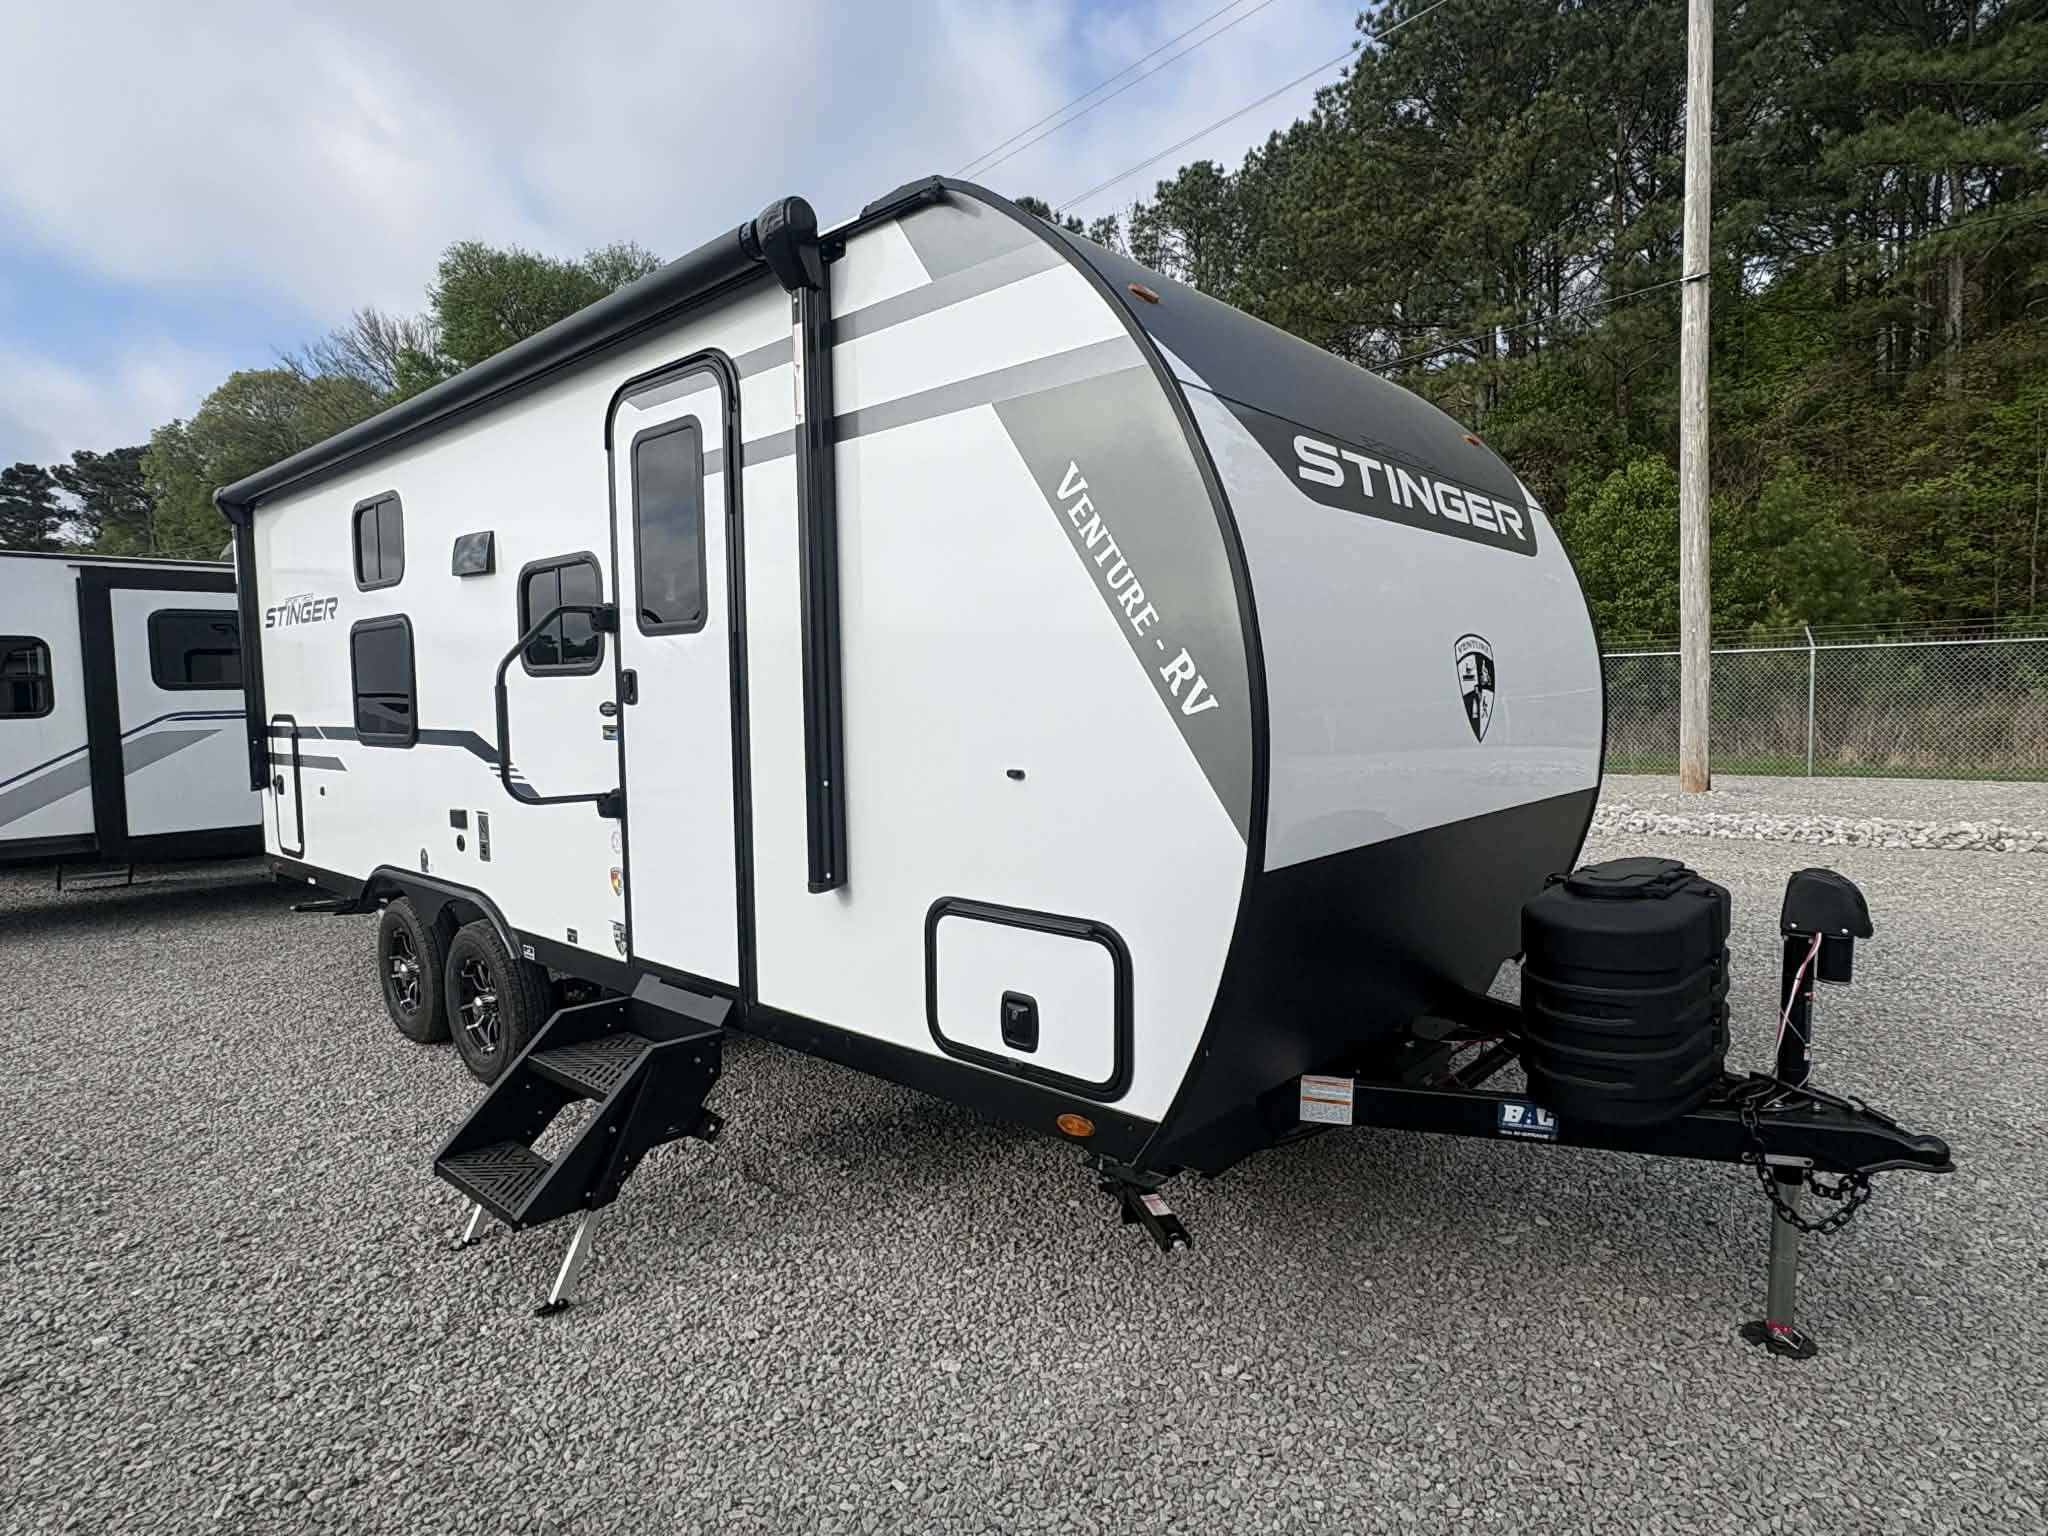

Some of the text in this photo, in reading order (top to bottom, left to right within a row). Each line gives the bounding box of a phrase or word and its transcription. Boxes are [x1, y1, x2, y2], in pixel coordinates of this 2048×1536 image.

[1293, 435, 1527, 541] STINGER
[1056, 460, 1160, 637] VENTURE
[1159, 647, 1219, 716] RV
[265, 597, 338, 628] STINGER
[1457, 639, 1490, 654] VENTURE
[1503, 1104, 1555, 1126] BAL
